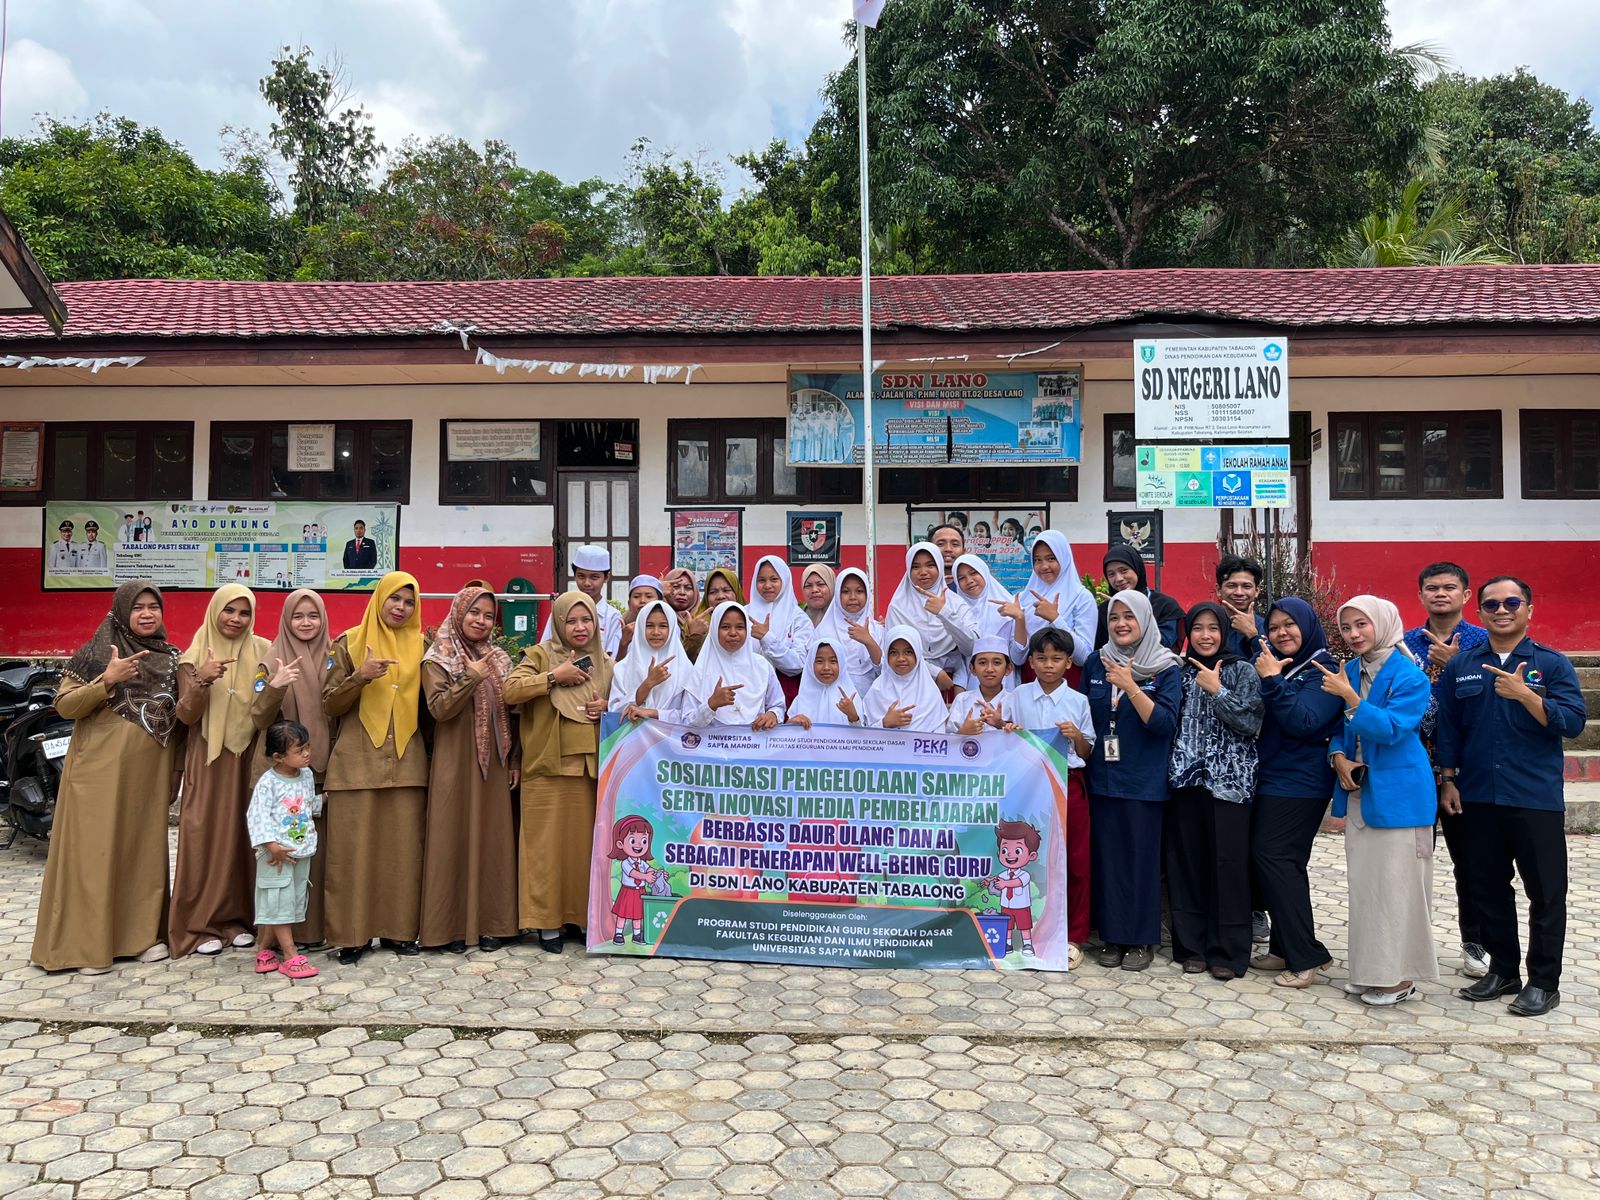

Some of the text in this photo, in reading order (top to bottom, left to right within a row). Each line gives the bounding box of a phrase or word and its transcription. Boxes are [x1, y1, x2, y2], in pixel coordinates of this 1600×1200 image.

[882, 373, 988, 389] SDN LANO
[1142, 365, 1281, 400] SD NEGERI LANO
[846, 391, 875, 399] ALAMT
[881, 391, 905, 399] JALAN
[939, 390, 961, 398] NOOR
[962, 390, 981, 398] RT.02
[983, 390, 1002, 398] DESA
[910, 401, 960, 409] VISI DAN MISI
[1224, 457, 1288, 468] SEKOLAH RAMAH ANAK
[172, 520, 269, 529] AYO DUKUNG
[913, 739, 948, 755] PEKA
[656, 760, 1006, 797] SOSIALISASI PENGELOLAAN SAMPAH
[662, 789, 999, 824] SERTA INOVASI MEDIA PEMBELAJARAN
[702, 819, 954, 849] BERBASIS DAUR ULANG DAN AI
[665, 844, 992, 878] SEBAGAI PENERAPAN WELL-BEING GURU
[690, 873, 964, 899] DI SDN LANO KABUPATEN TABALONG
[783, 910, 847, 920] Diselenggarakan
[697, 918, 953, 937] PROGRAM STUDI PENDIDIKAN GURU SEKOLAH DASAR
[716, 930, 933, 947] FAKULTAS KEGURUAN DAN ILMU PENDIDIKAN
[752, 943, 896, 958] UNIVERSITAS SAPTA MANDIRI
